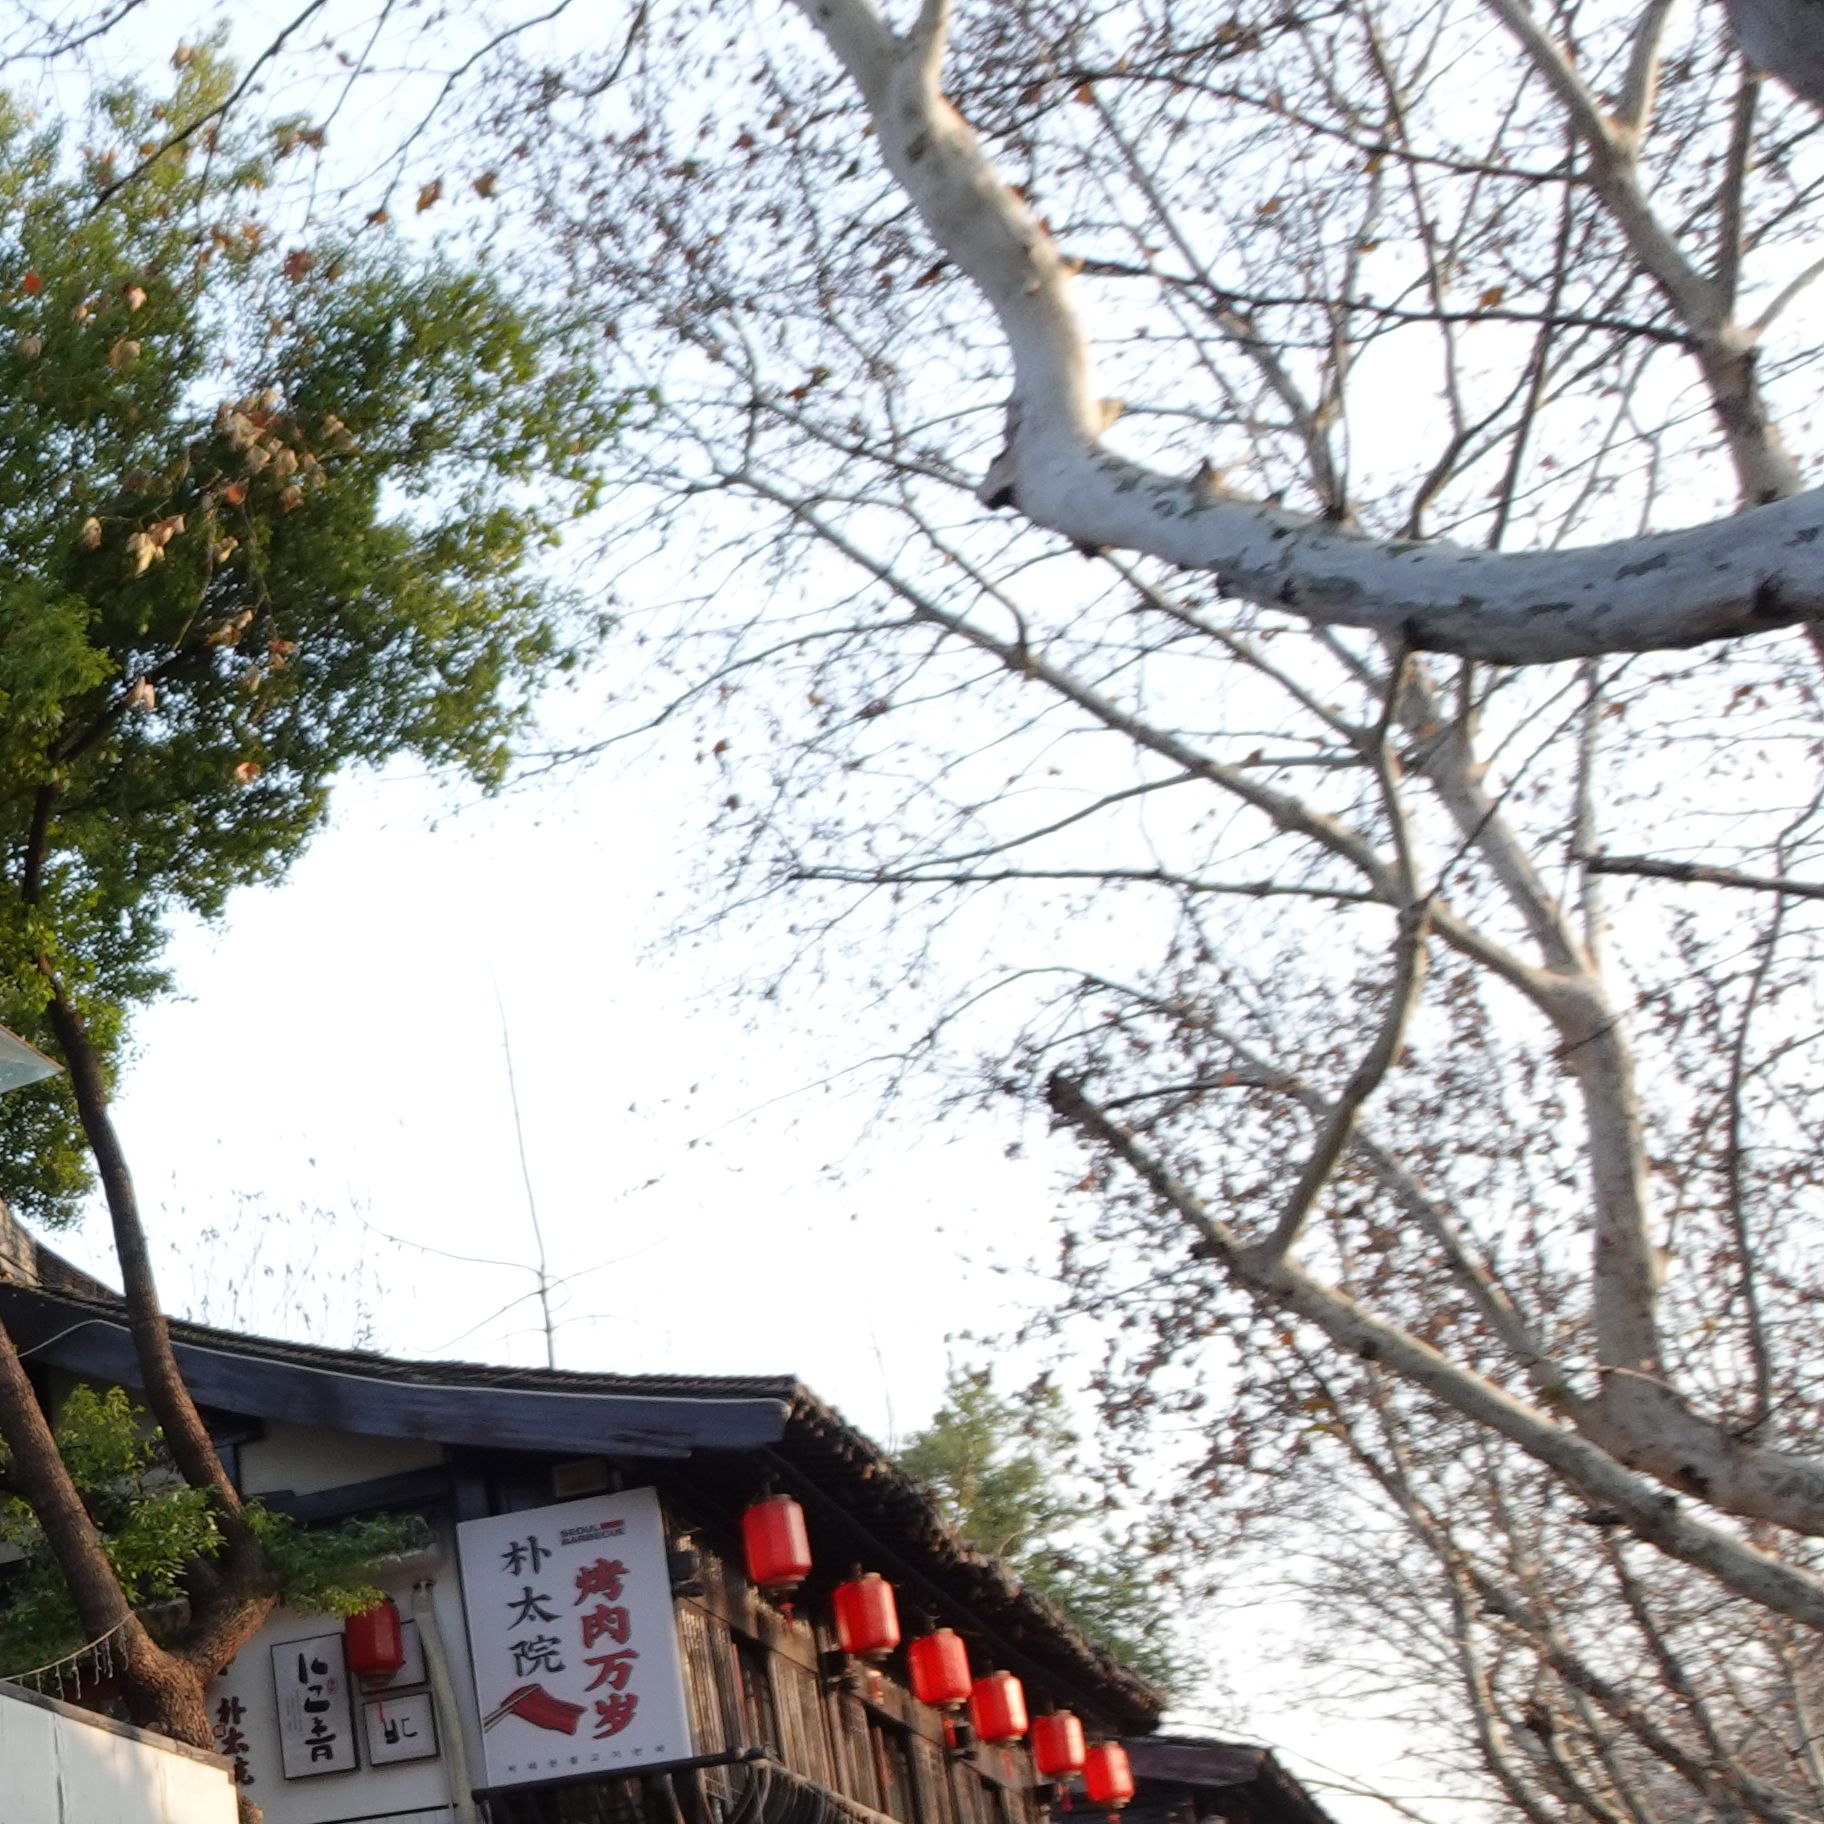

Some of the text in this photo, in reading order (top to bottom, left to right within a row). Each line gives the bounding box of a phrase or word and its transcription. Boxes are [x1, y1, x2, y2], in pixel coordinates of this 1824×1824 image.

[501, 1535, 567, 1677] 朴太院
[574, 1557, 640, 1741] 烤肉万岁
